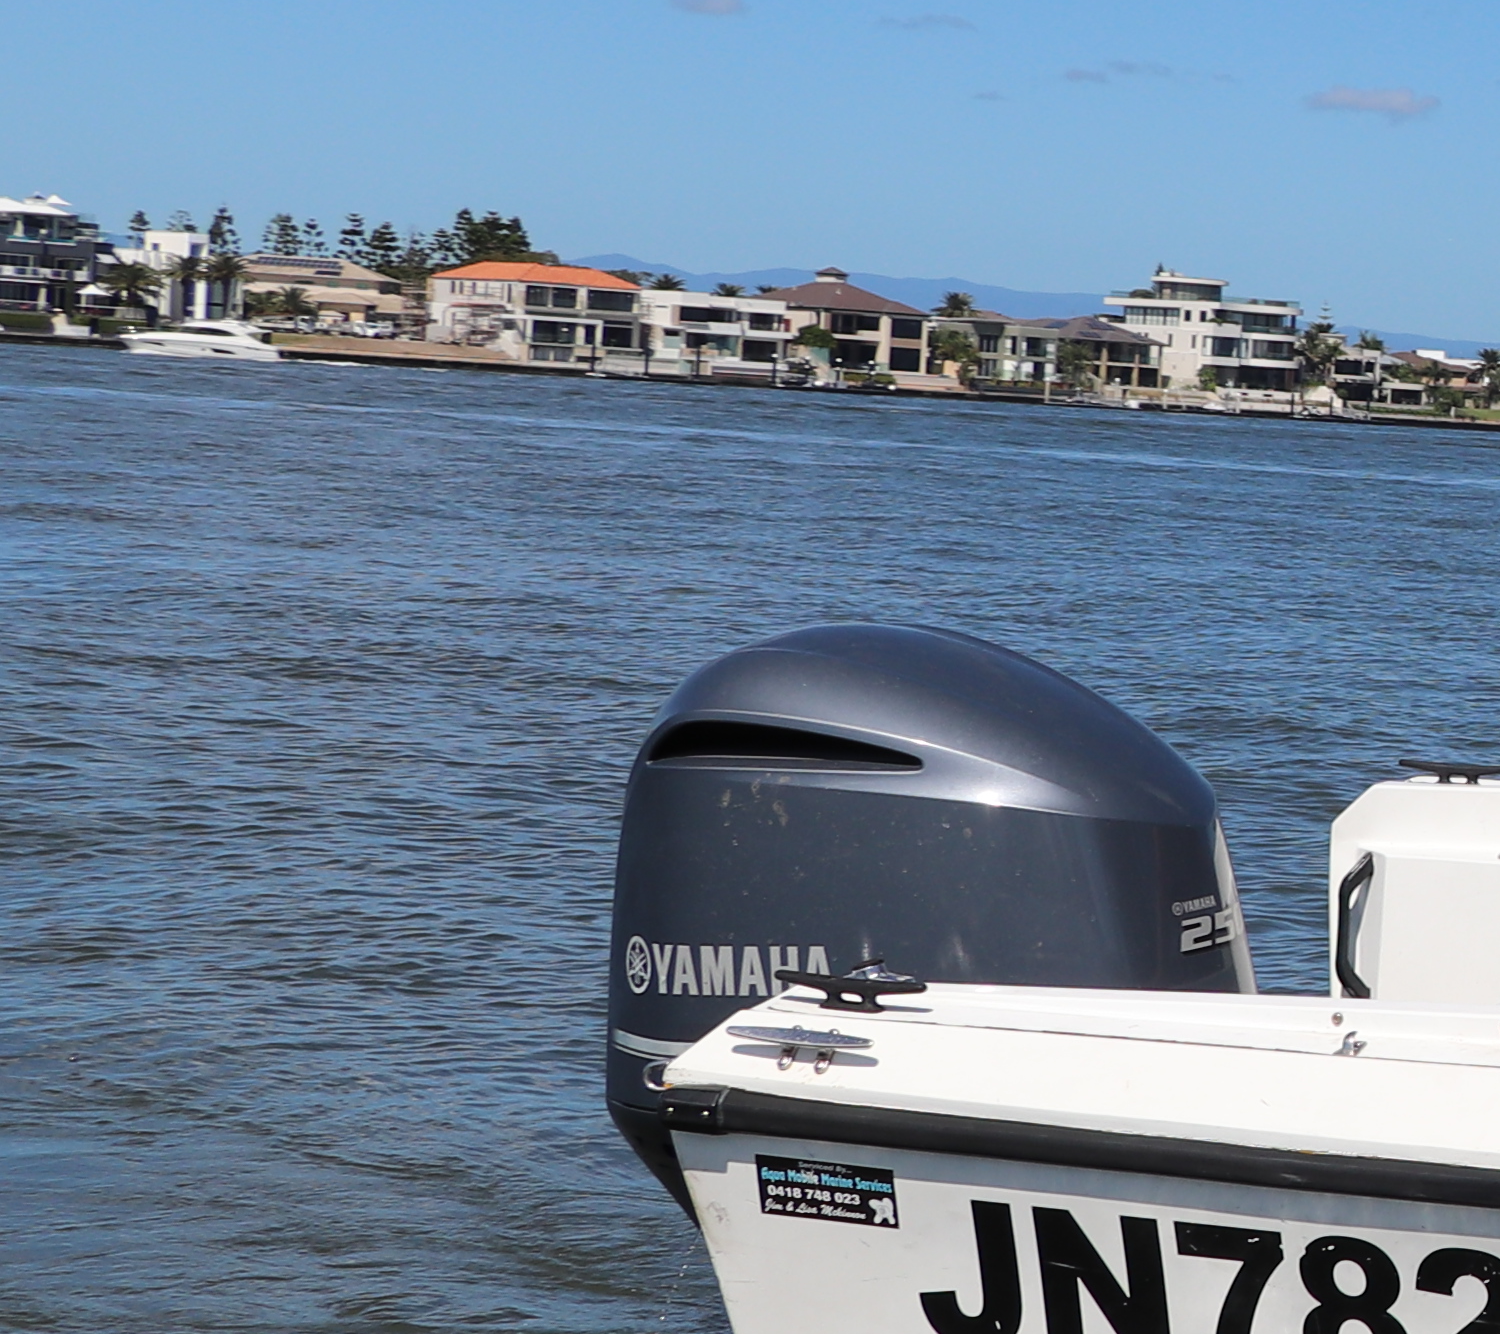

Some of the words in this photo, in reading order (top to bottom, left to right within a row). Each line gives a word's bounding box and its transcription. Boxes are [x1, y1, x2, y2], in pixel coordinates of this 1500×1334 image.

[1182, 895, 1217, 913] YAMAHA
[652, 943, 831, 996] YAMAHA
[761, 1167, 785, 1182] Aqua
[788, 1169, 819, 1185] Mobile
[821, 1173, 853, 1188] Marine
[855, 1177, 892, 1193] Services
[767, 1184, 802, 1198] 0418
[804, 1188, 832, 1201] 748
[834, 1192, 861, 1205] 023
